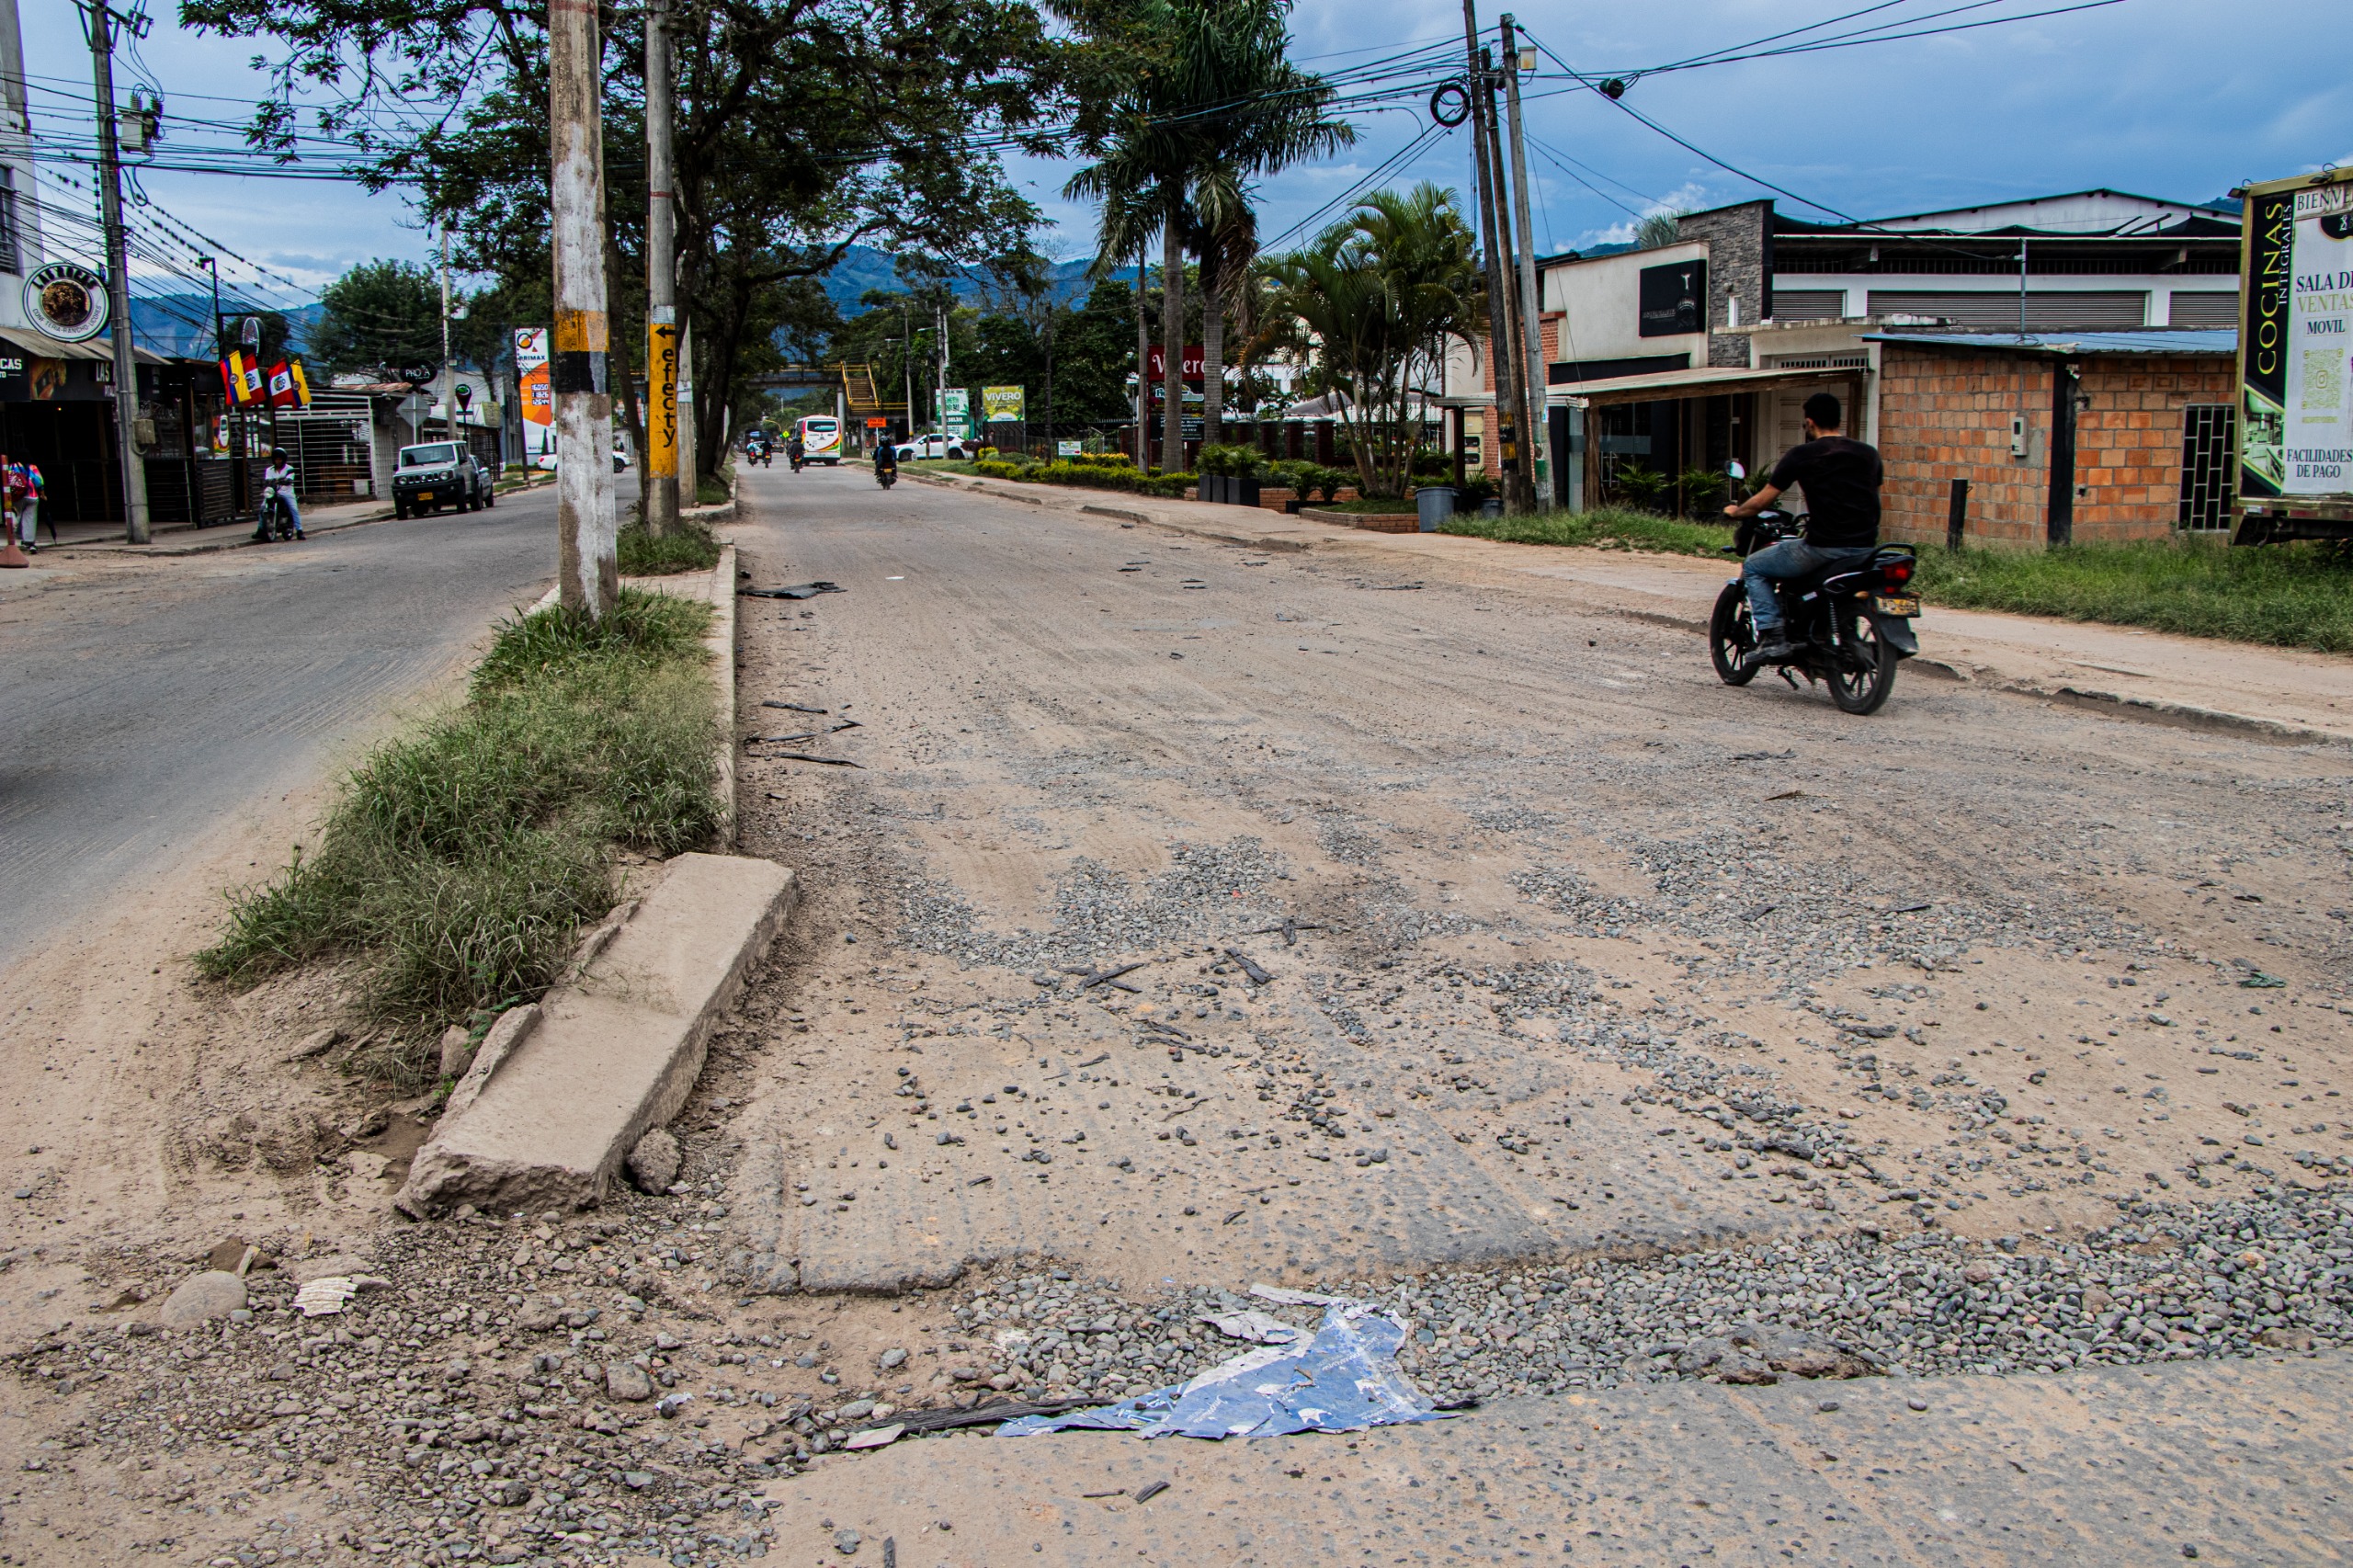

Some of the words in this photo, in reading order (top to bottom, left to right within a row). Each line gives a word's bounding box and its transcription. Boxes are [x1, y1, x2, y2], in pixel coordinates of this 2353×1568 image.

[2278, 204, 2293, 305] INTEGRALES
[2257, 202, 2284, 375] COCINAS
[2296, 273, 2334, 293] SALA
[2338, 269, 2353, 290] D
[2307, 319, 2346, 335] MOVIL
[661, 347, 676, 448] efecty
[985, 392, 1021, 402] VIVERO
[2287, 449, 2353, 463] FACILIDADES
[2296, 464, 2311, 478] DE
[2313, 464, 2341, 479] PAGO
